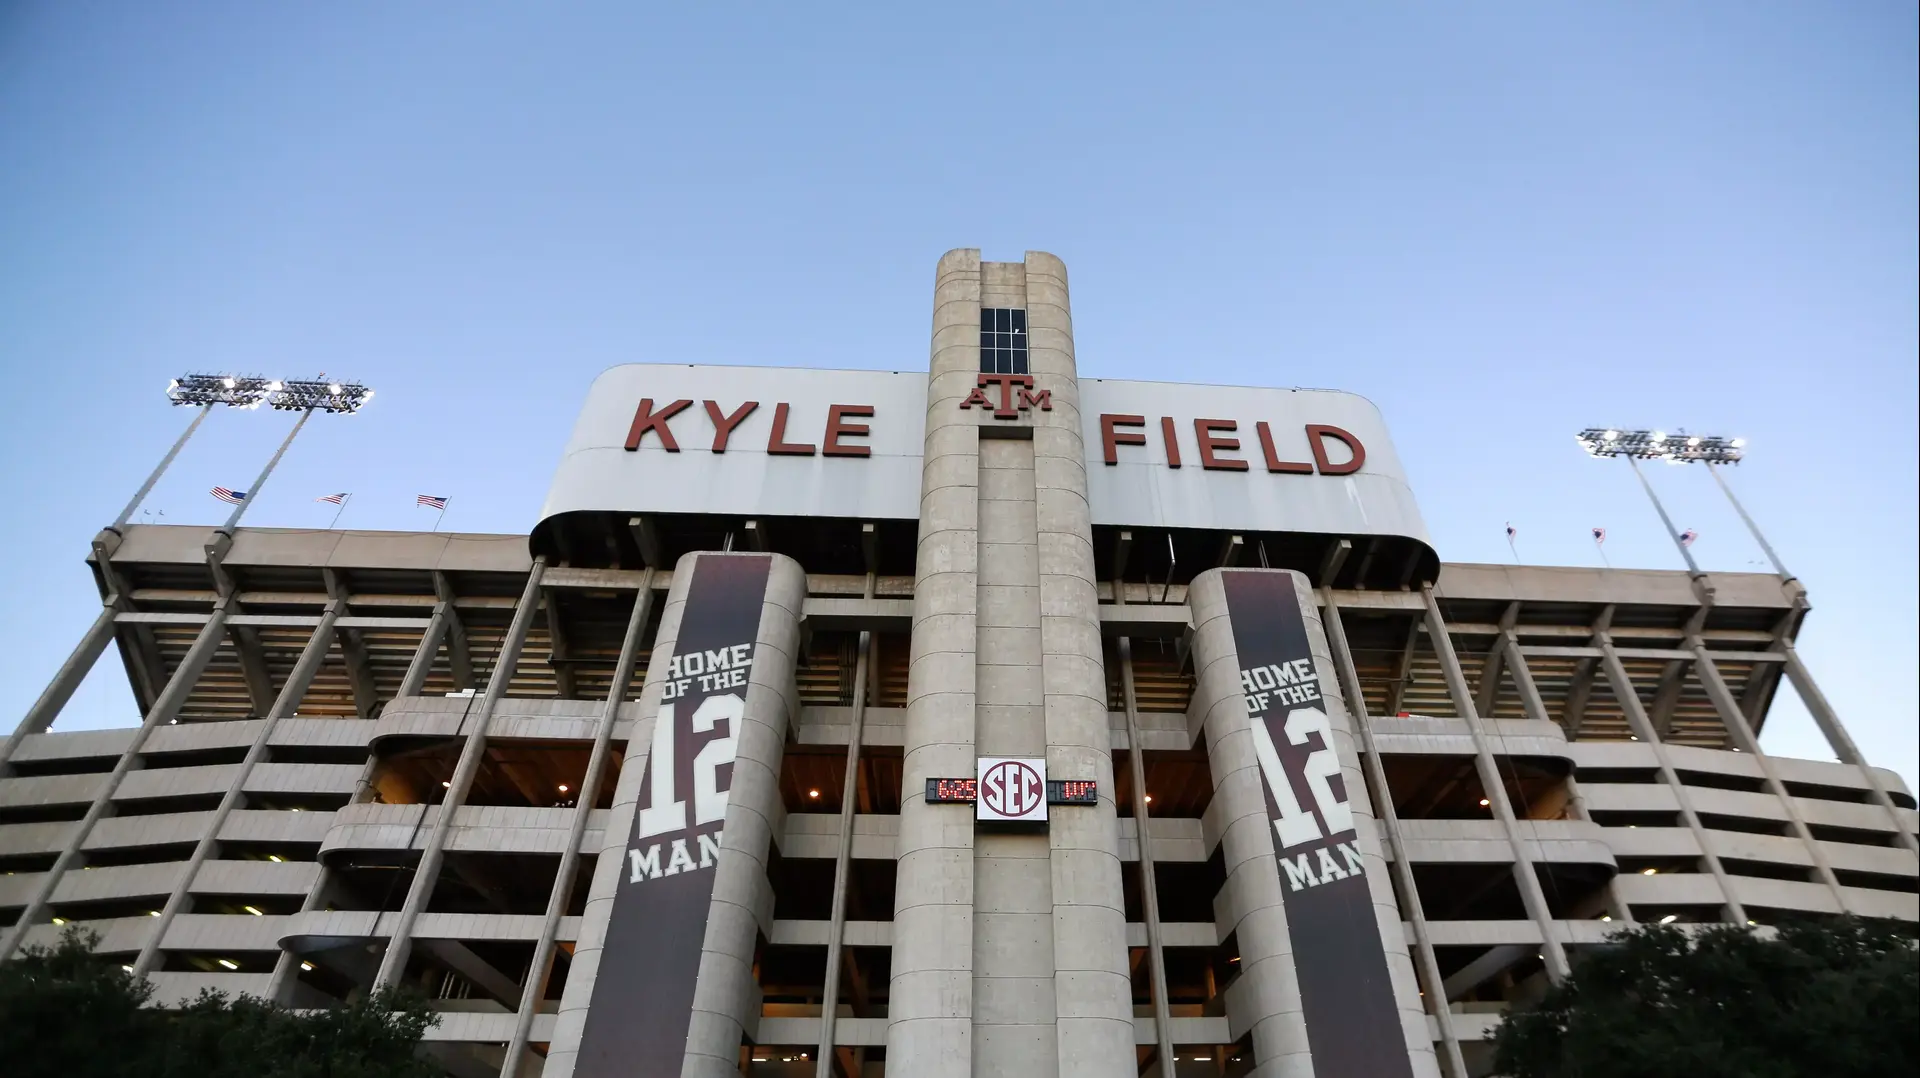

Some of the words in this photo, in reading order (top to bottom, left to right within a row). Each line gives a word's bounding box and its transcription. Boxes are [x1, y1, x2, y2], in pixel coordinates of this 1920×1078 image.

[624, 398, 875, 458] KYLE
[1100, 413, 1366, 476] FIELD
[662, 679, 691, 699] OF
[697, 669, 746, 693] THE
[664, 643, 752, 680] HOME
[1241, 658, 1317, 694] HOME
[1245, 692, 1270, 713] OF
[1273, 683, 1321, 706] THE
[639, 692, 745, 839] 12
[938, 780, 976, 799] 6:25
[985, 763, 1038, 814] SEC
[1250, 706, 1355, 849] 12
[629, 831, 721, 884] MAN
[1279, 840, 1365, 892] MAN
